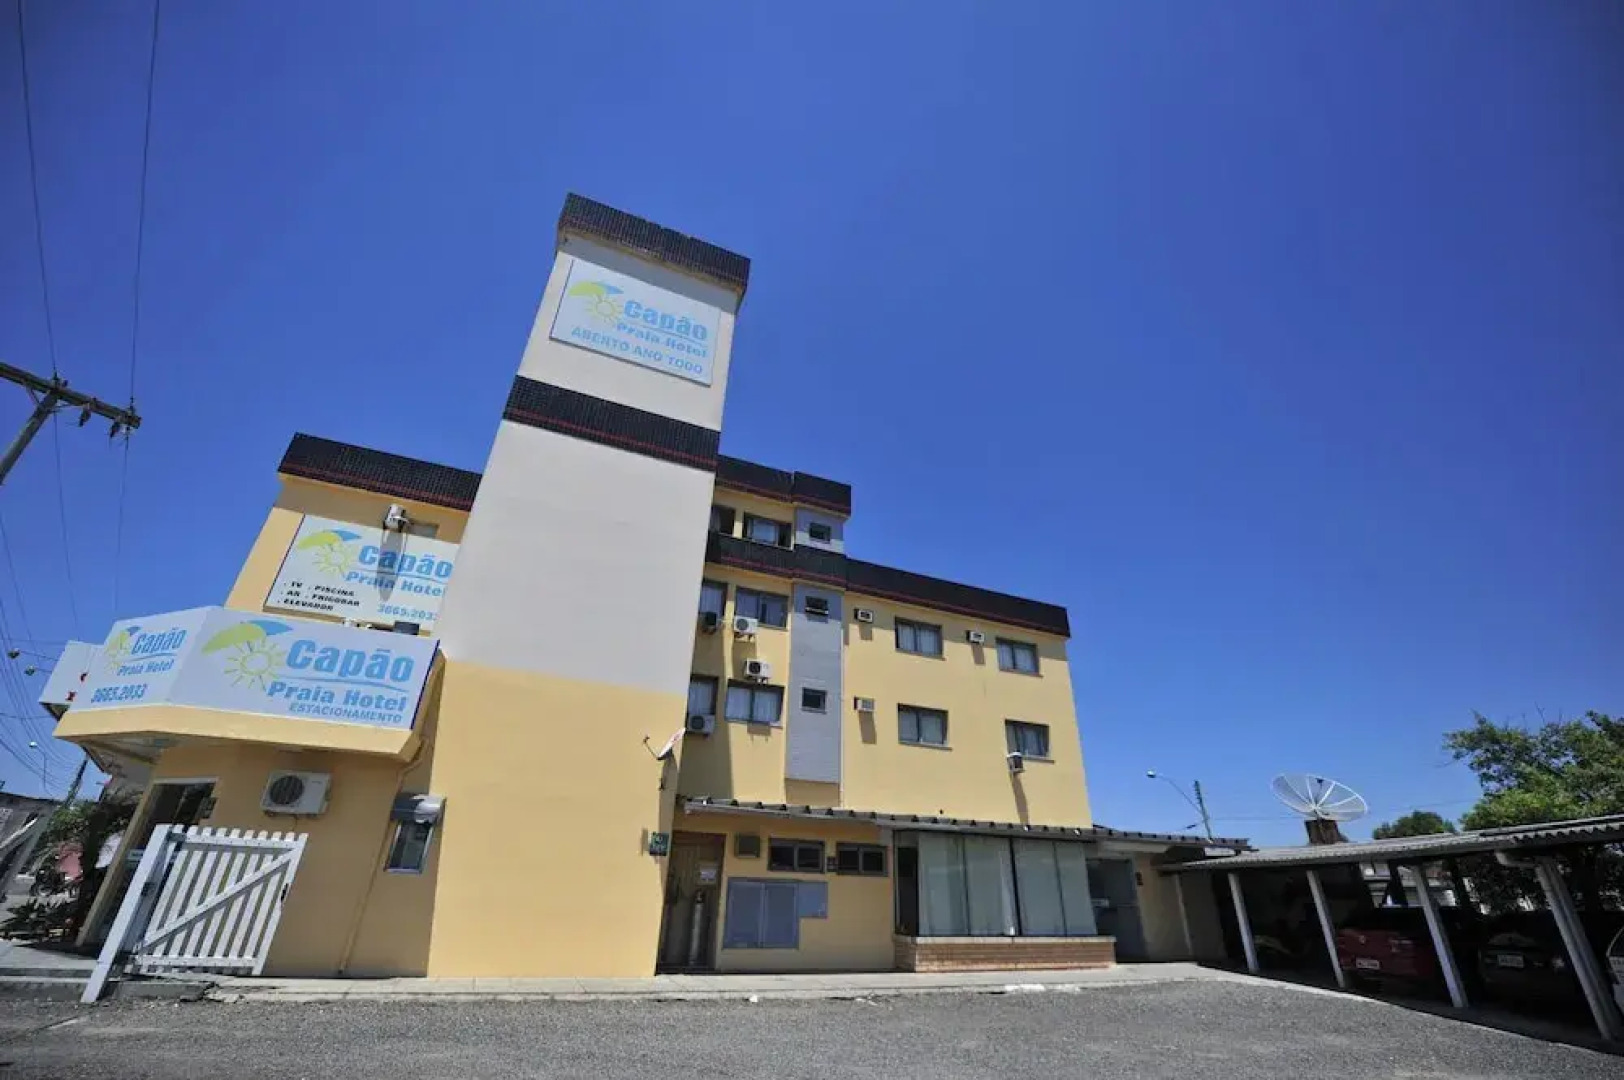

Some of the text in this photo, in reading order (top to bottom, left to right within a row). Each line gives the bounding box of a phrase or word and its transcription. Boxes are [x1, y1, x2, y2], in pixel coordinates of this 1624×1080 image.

[623, 300, 708, 340] Capão
[571, 326, 703, 374] ABERTO ANO TODO
[616, 322, 707, 358] Praia Hotel
[358, 545, 453, 578] Capão
[314, 585, 355, 597] PISCINA
[345, 571, 396, 589] Praia
[283, 598, 334, 611] ELEVADOR
[312, 593, 360, 607] FRIGOBAR
[377, 603, 439, 621] 3665.203
[131, 627, 187, 654] Capão
[117, 659, 175, 676] Praia Hotel
[286, 640, 415, 683] Capão
[267, 681, 407, 712] Praia Hotel
[287, 702, 402, 723] ESTACIONAMENTO
